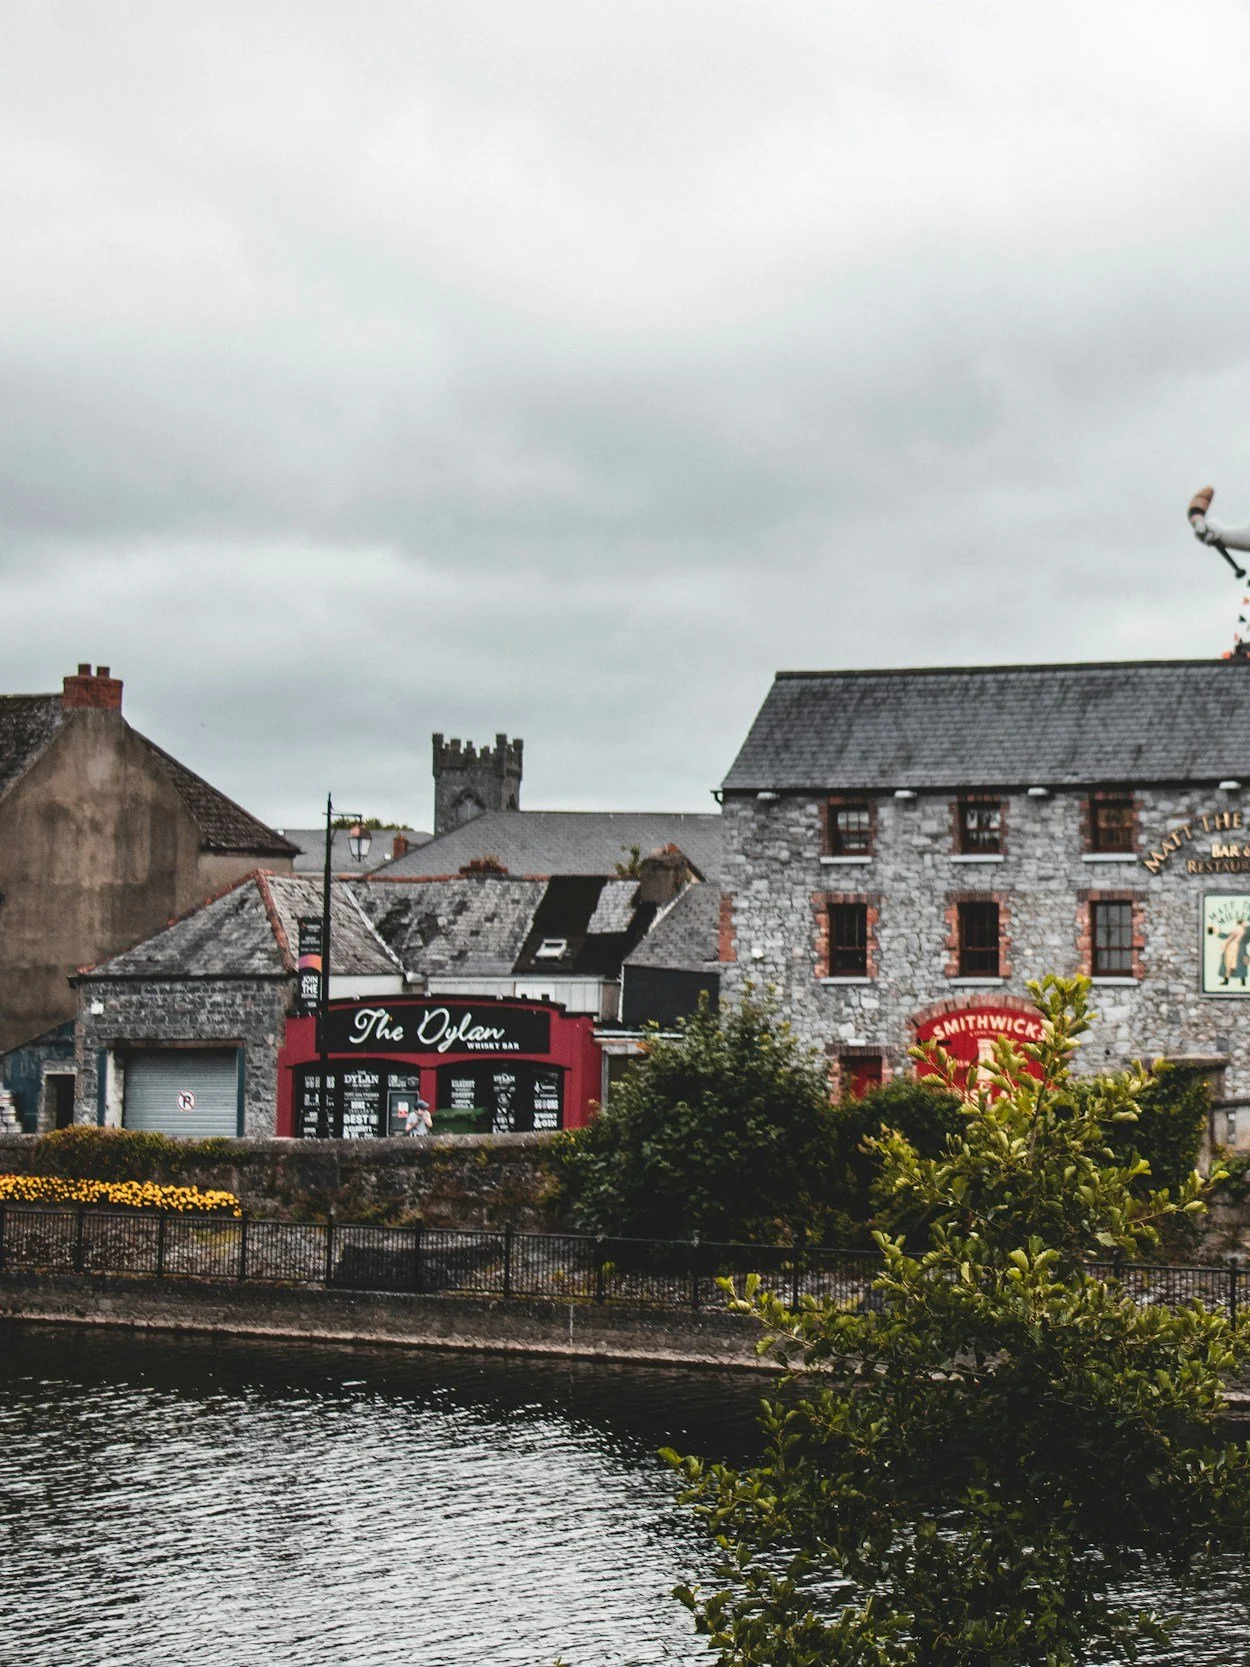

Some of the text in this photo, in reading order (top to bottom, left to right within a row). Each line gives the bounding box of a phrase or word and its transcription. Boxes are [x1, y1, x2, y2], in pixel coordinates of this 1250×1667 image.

[1143, 824, 1193, 874] MATT
[1201, 811, 1244, 833] THE
[1211, 844, 1240, 858] BAR
[302, 984, 319, 994] THE
[349, 1007, 505, 1053] The Dylan
[467, 1042, 520, 1050] WHISKY BAR
[343, 1074, 379, 1084] DYLAN
[343, 1113, 369, 1125] BEST
